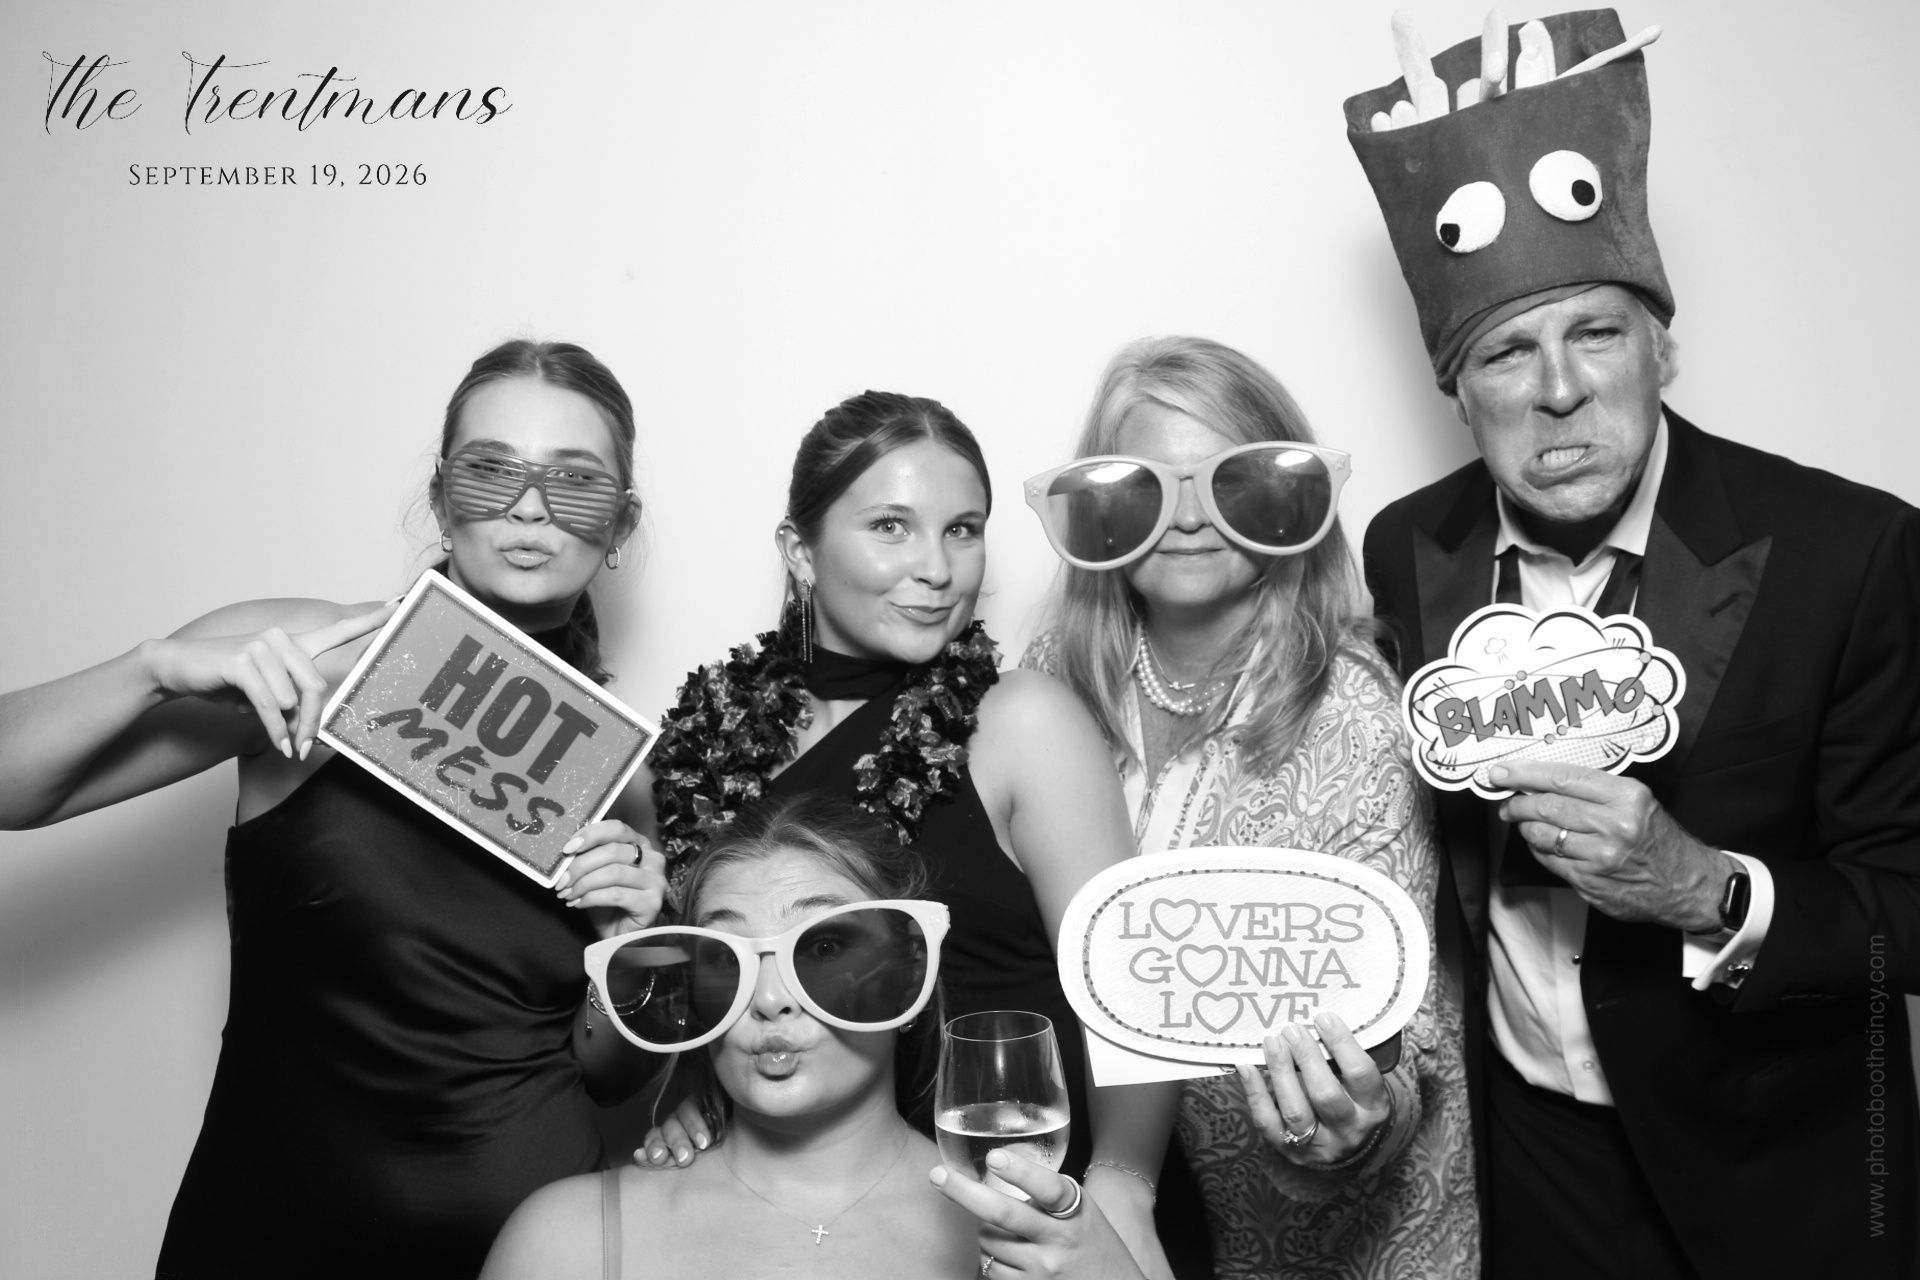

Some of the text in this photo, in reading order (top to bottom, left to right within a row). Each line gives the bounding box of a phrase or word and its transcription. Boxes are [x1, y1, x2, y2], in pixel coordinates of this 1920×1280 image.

[366, 707, 565, 835] MESS
[418, 633, 599, 785] HOT
[1434, 668, 1646, 748] BLAMMO
